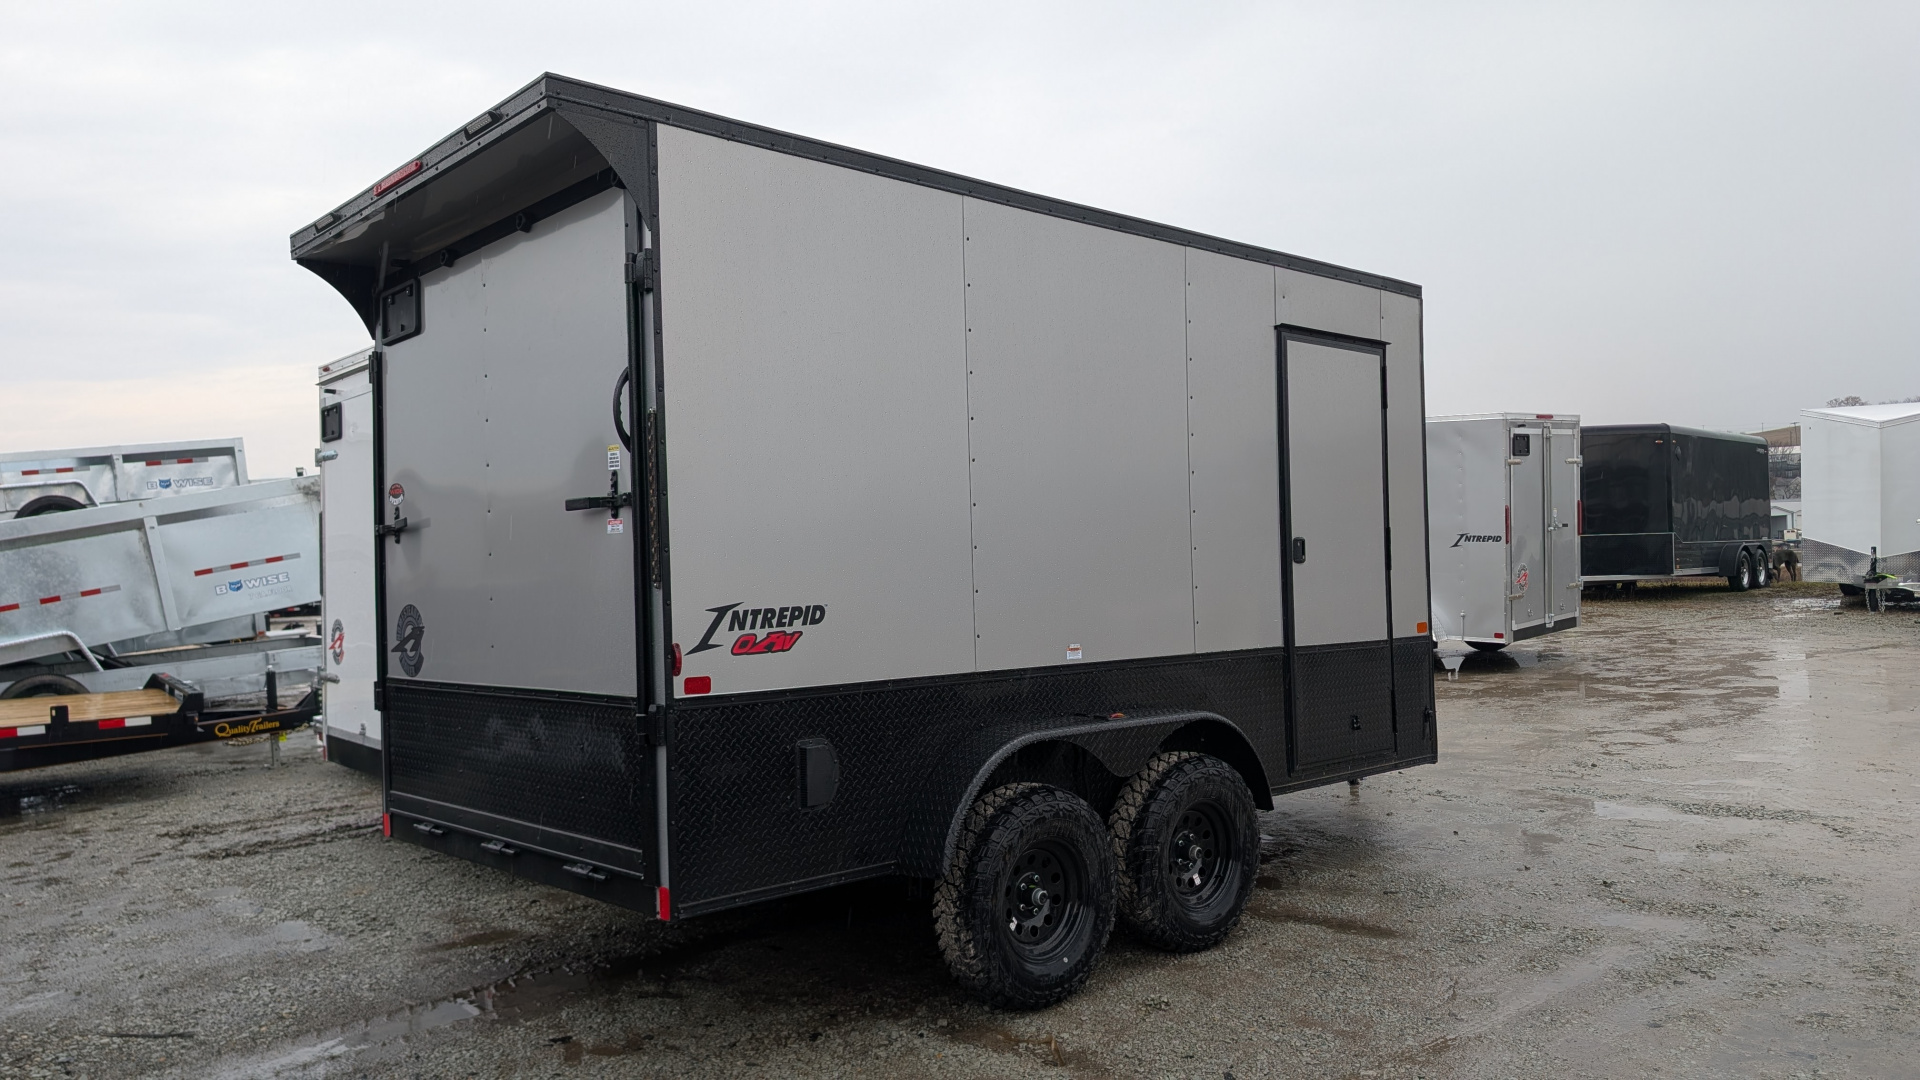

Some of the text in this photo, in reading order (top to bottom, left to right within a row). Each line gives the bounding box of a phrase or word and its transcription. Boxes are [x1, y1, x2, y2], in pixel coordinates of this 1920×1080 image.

[1449, 532, 1502, 548] INTREPID
[684, 601, 827, 656] INTREPID
[214, 717, 280, 737] Quality Trailers
